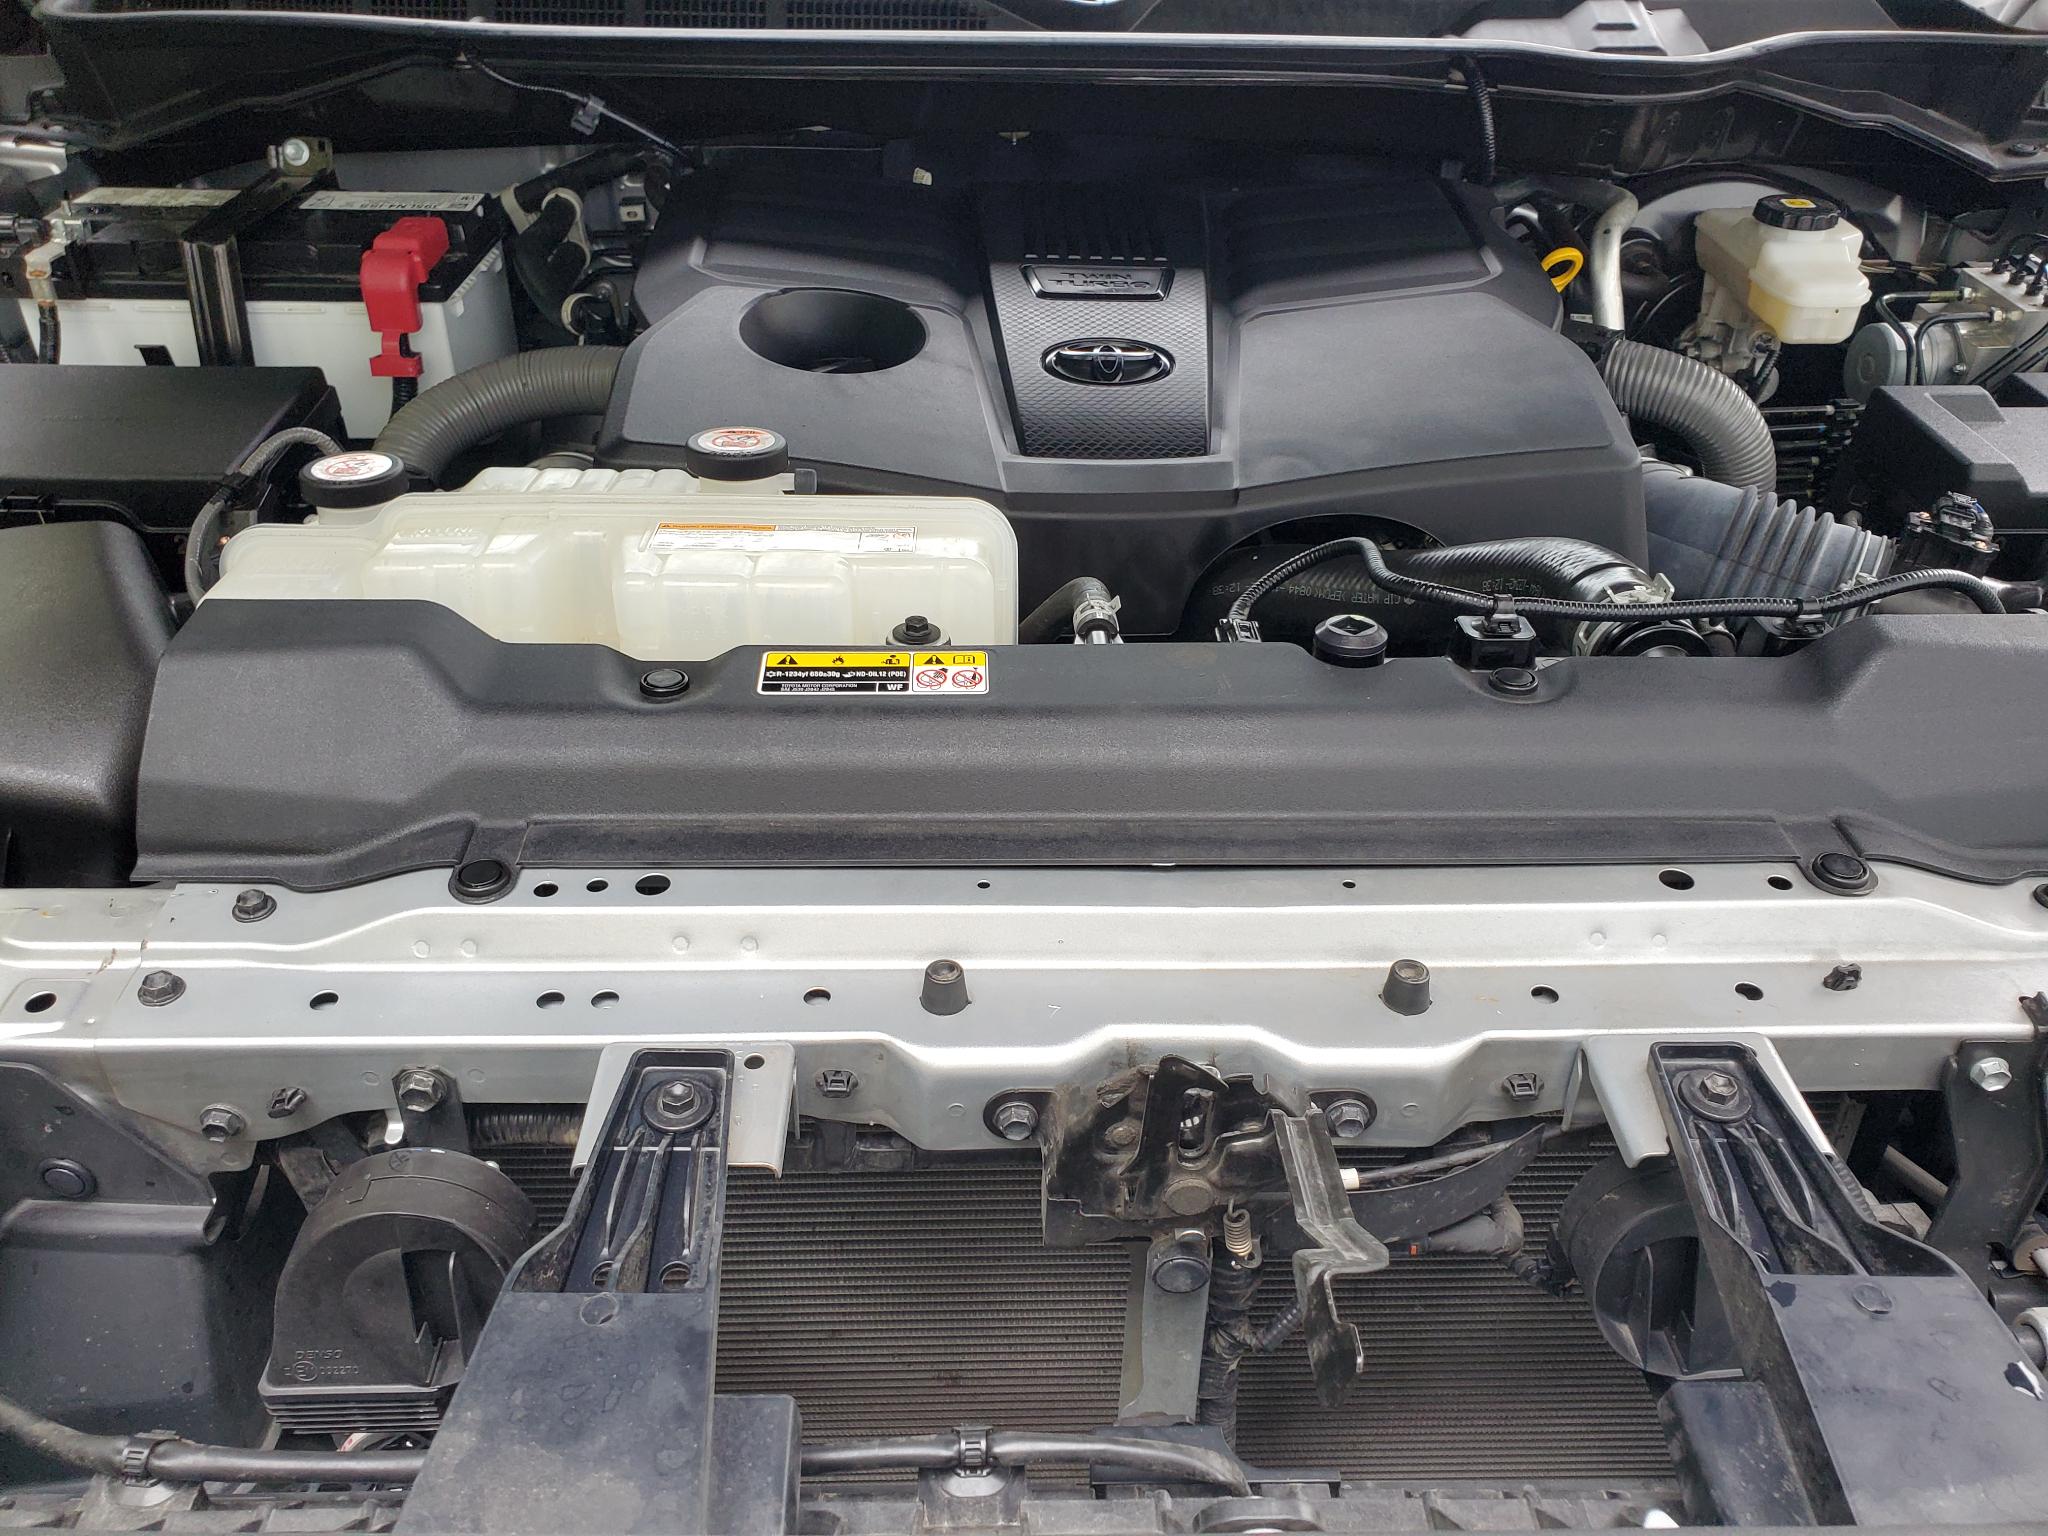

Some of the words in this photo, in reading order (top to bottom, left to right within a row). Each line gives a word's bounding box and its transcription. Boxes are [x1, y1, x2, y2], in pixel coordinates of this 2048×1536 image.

[1060, 272, 1132, 280] TWIN
[1048, 279, 1151, 288] TURBO
[776, 670, 809, 678] R-1234yf
[888, 669, 907, 679] (POE)
[886, 683, 904, 691] WF
[295, 1349, 343, 1360] DENSO
